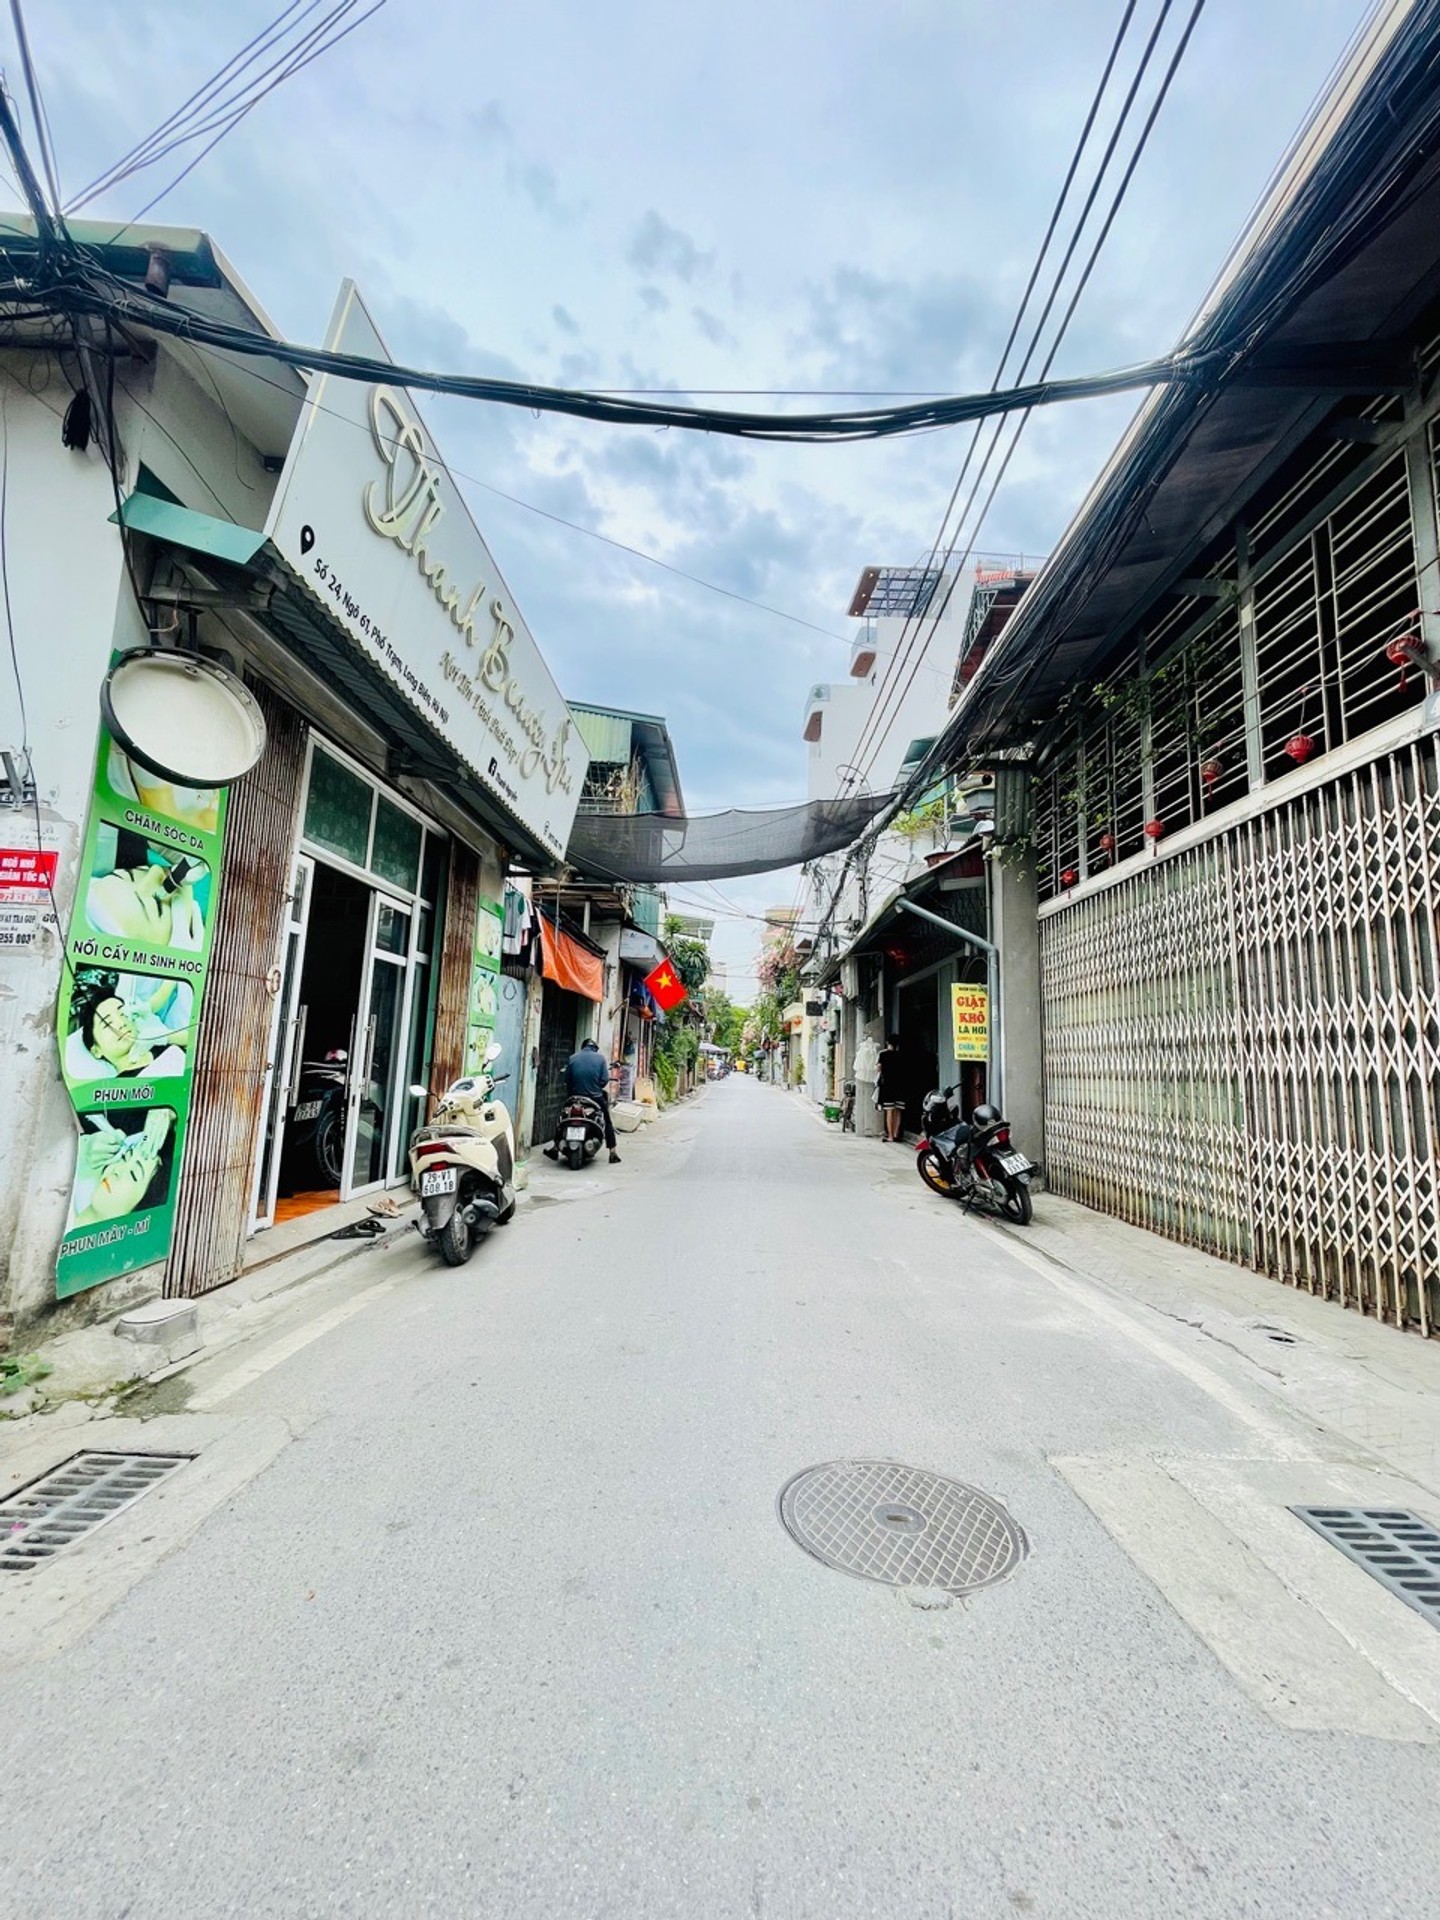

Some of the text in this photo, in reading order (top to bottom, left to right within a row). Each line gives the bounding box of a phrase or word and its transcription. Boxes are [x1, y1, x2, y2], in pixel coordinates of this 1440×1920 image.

[363, 382, 486, 648] Thanh
[313, 558, 330, 580] Số
[328, 574, 342, 601] 24,
[342, 592, 360, 619] Ngõ
[360, 615, 370, 635] 61,
[370, 626, 388, 650] Phố
[403, 664, 418, 692] Long
[124, 810, 204, 850] CHĂM SÓC DA
[73, 938, 203, 976] NỐI CẤY MI SINH HỌC
[956, 994, 986, 1010] GIẶT
[959, 1011, 986, 1024] KHÔ
[94, 1084, 155, 1102] PHUN MÔI
[60, 1234, 97, 1258] PHUN
